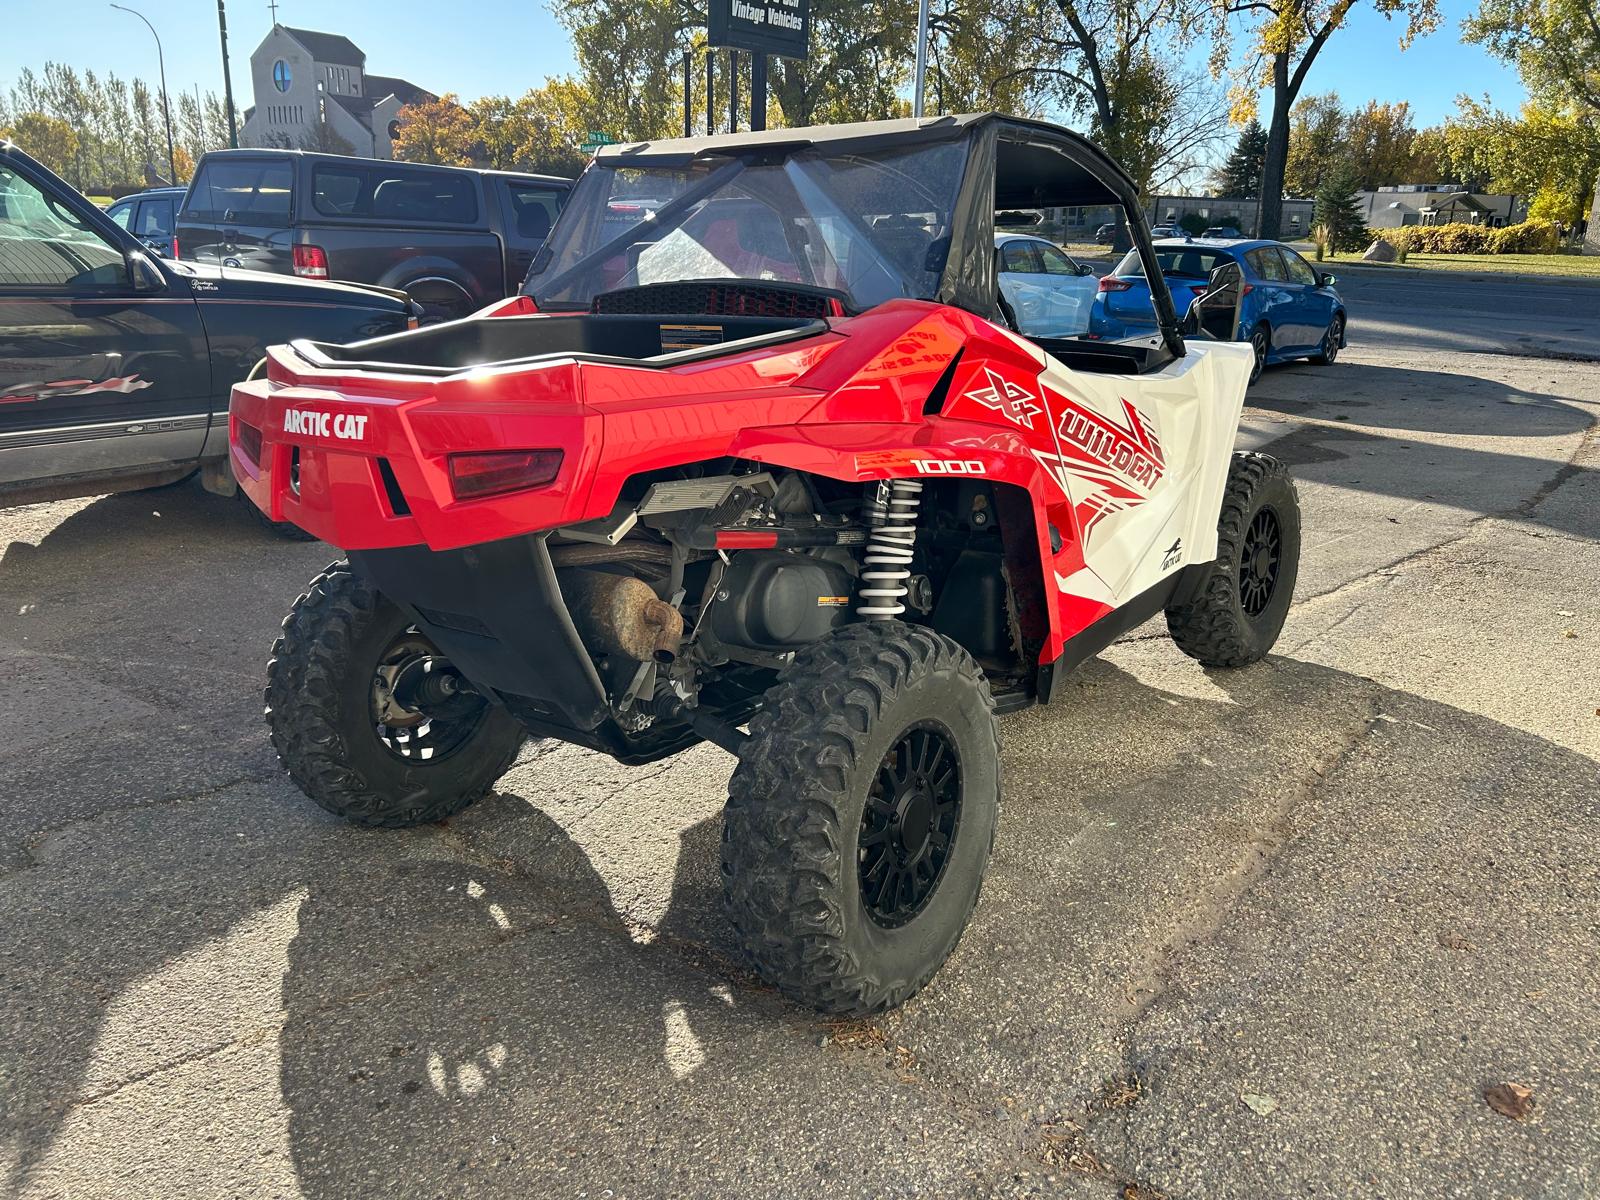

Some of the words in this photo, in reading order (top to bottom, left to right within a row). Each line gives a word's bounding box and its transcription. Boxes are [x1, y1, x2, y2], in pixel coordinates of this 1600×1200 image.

[731, 0, 765, 24] Vintage
[768, 7, 802, 30] Vehicles
[284, 409, 330, 437] ARCTIC
[333, 413, 368, 440] CAT
[1058, 408, 1164, 490] WILDCAT
[910, 459, 986, 474] 1000
